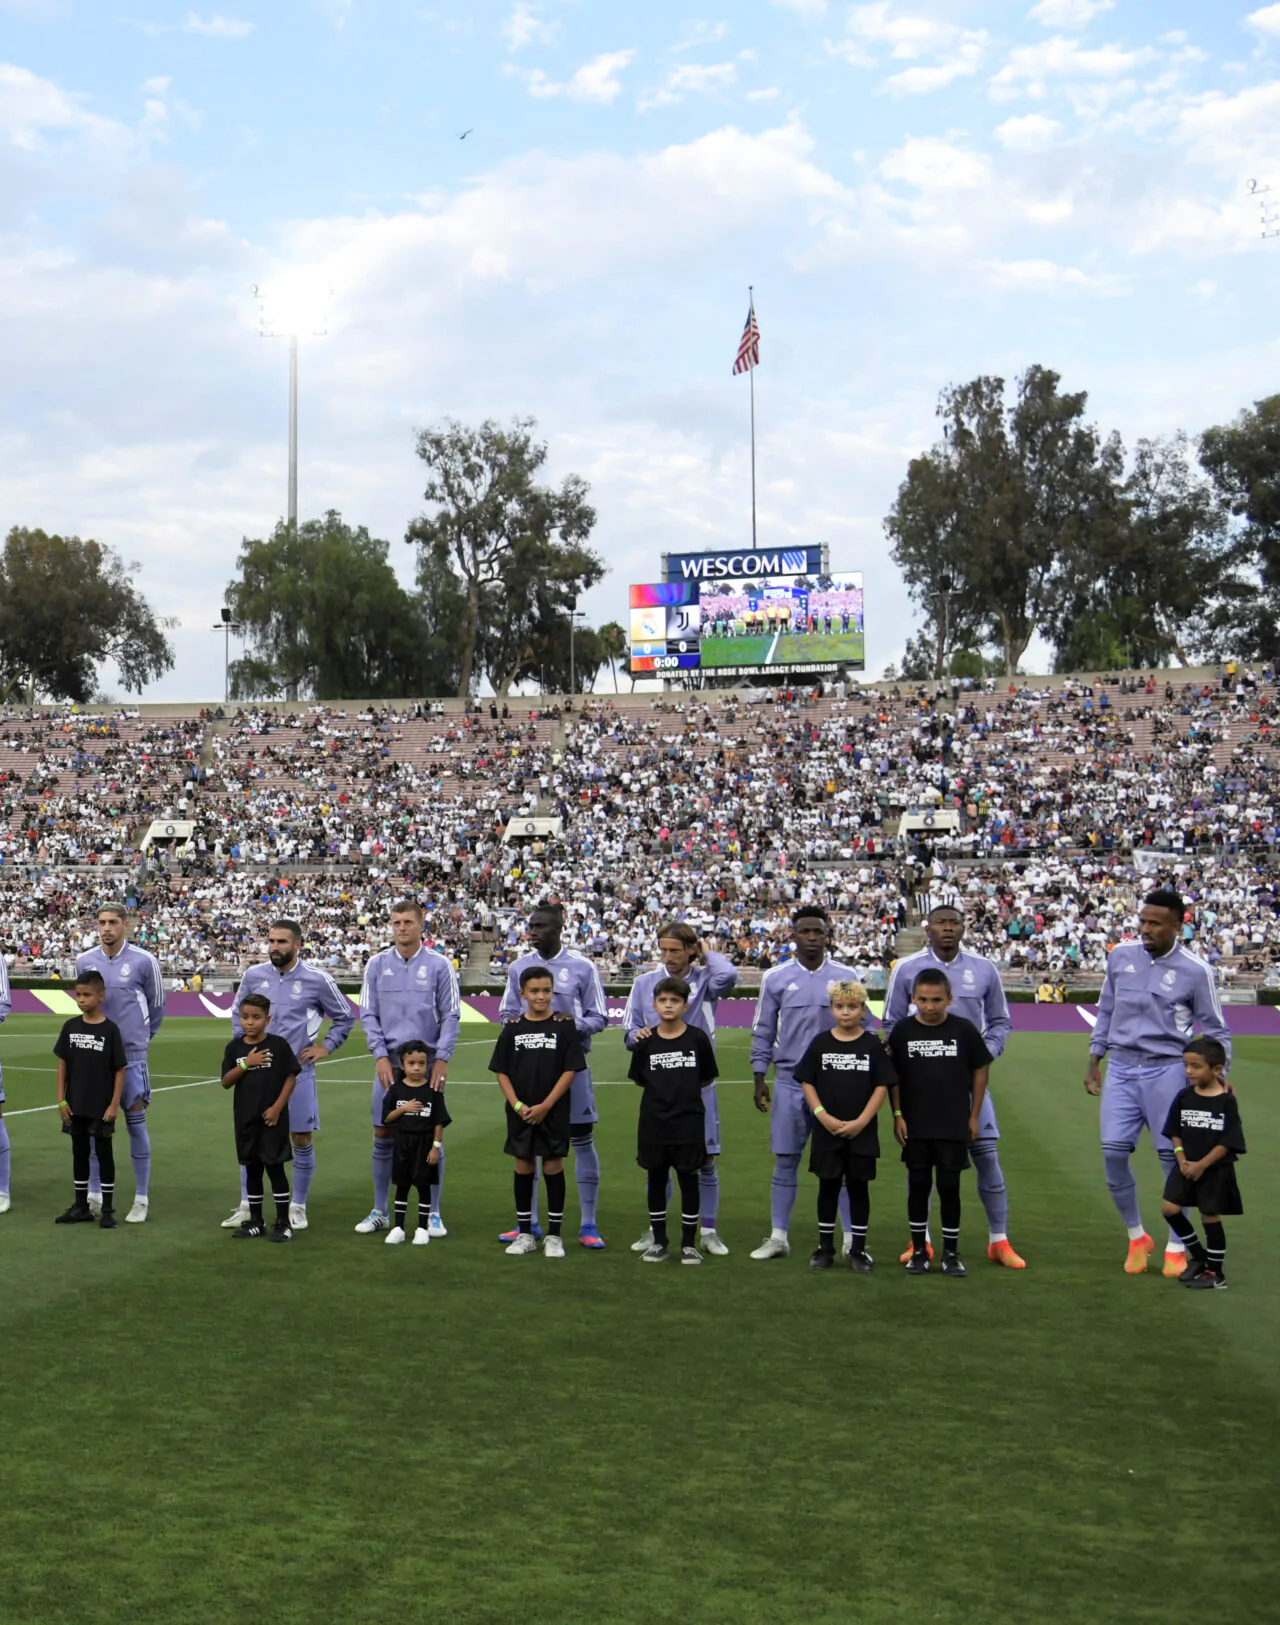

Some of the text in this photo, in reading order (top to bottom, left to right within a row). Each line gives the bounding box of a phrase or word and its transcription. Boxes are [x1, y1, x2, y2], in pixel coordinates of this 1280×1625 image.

[681, 554, 779, 578] WESCOM
[654, 657, 678, 667] 0:00
[702, 668, 715, 676] THE
[738, 666, 759, 674] BOWL
[762, 666, 788, 674] LEGACY
[792, 664, 837, 672] FOUNDATION
[650, 1051, 682, 1059] SOCCER
[650, 1056, 696, 1065] CHAMPIONS
